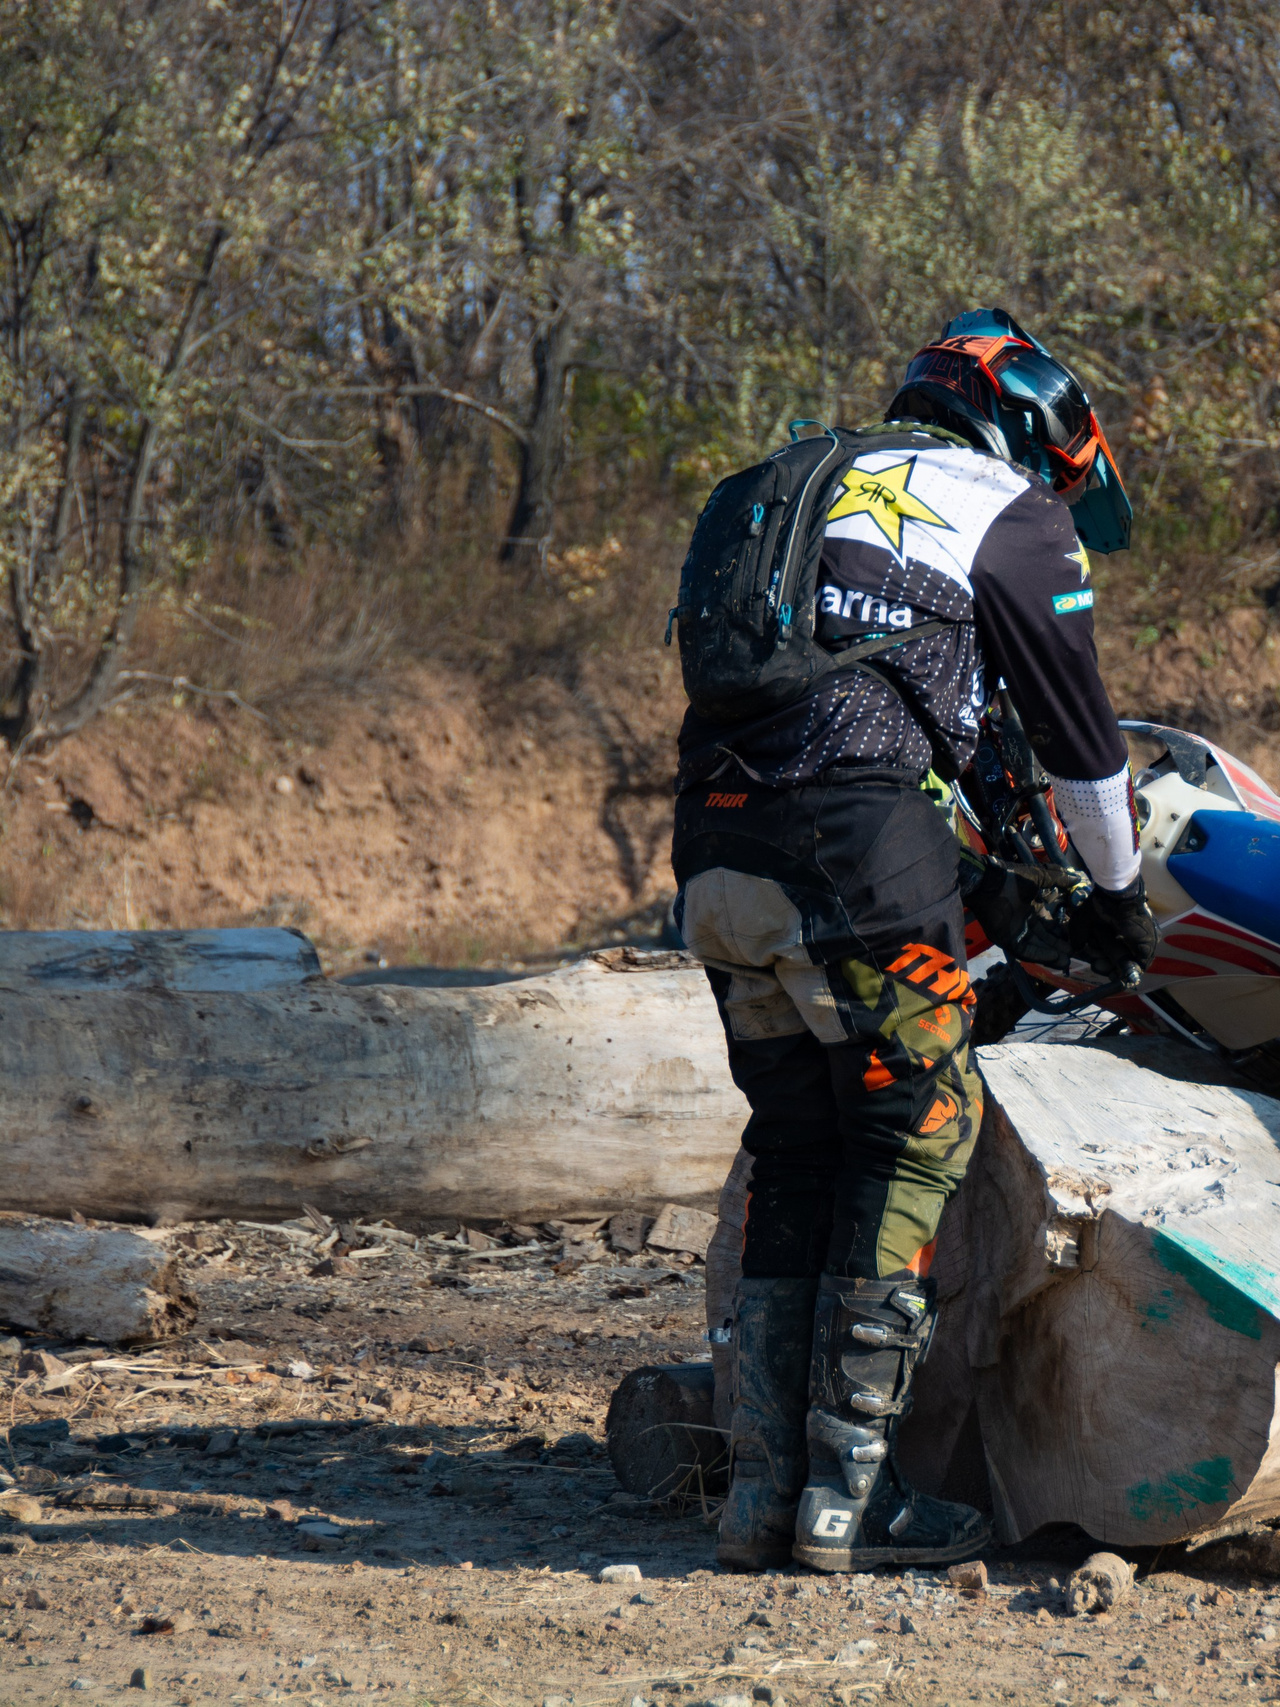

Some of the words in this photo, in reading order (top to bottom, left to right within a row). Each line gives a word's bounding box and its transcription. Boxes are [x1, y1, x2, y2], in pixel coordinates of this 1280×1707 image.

[704, 792, 748, 808] THOR
[917, 1018, 951, 1044] SECTOR
[812, 1508, 853, 1538] G
